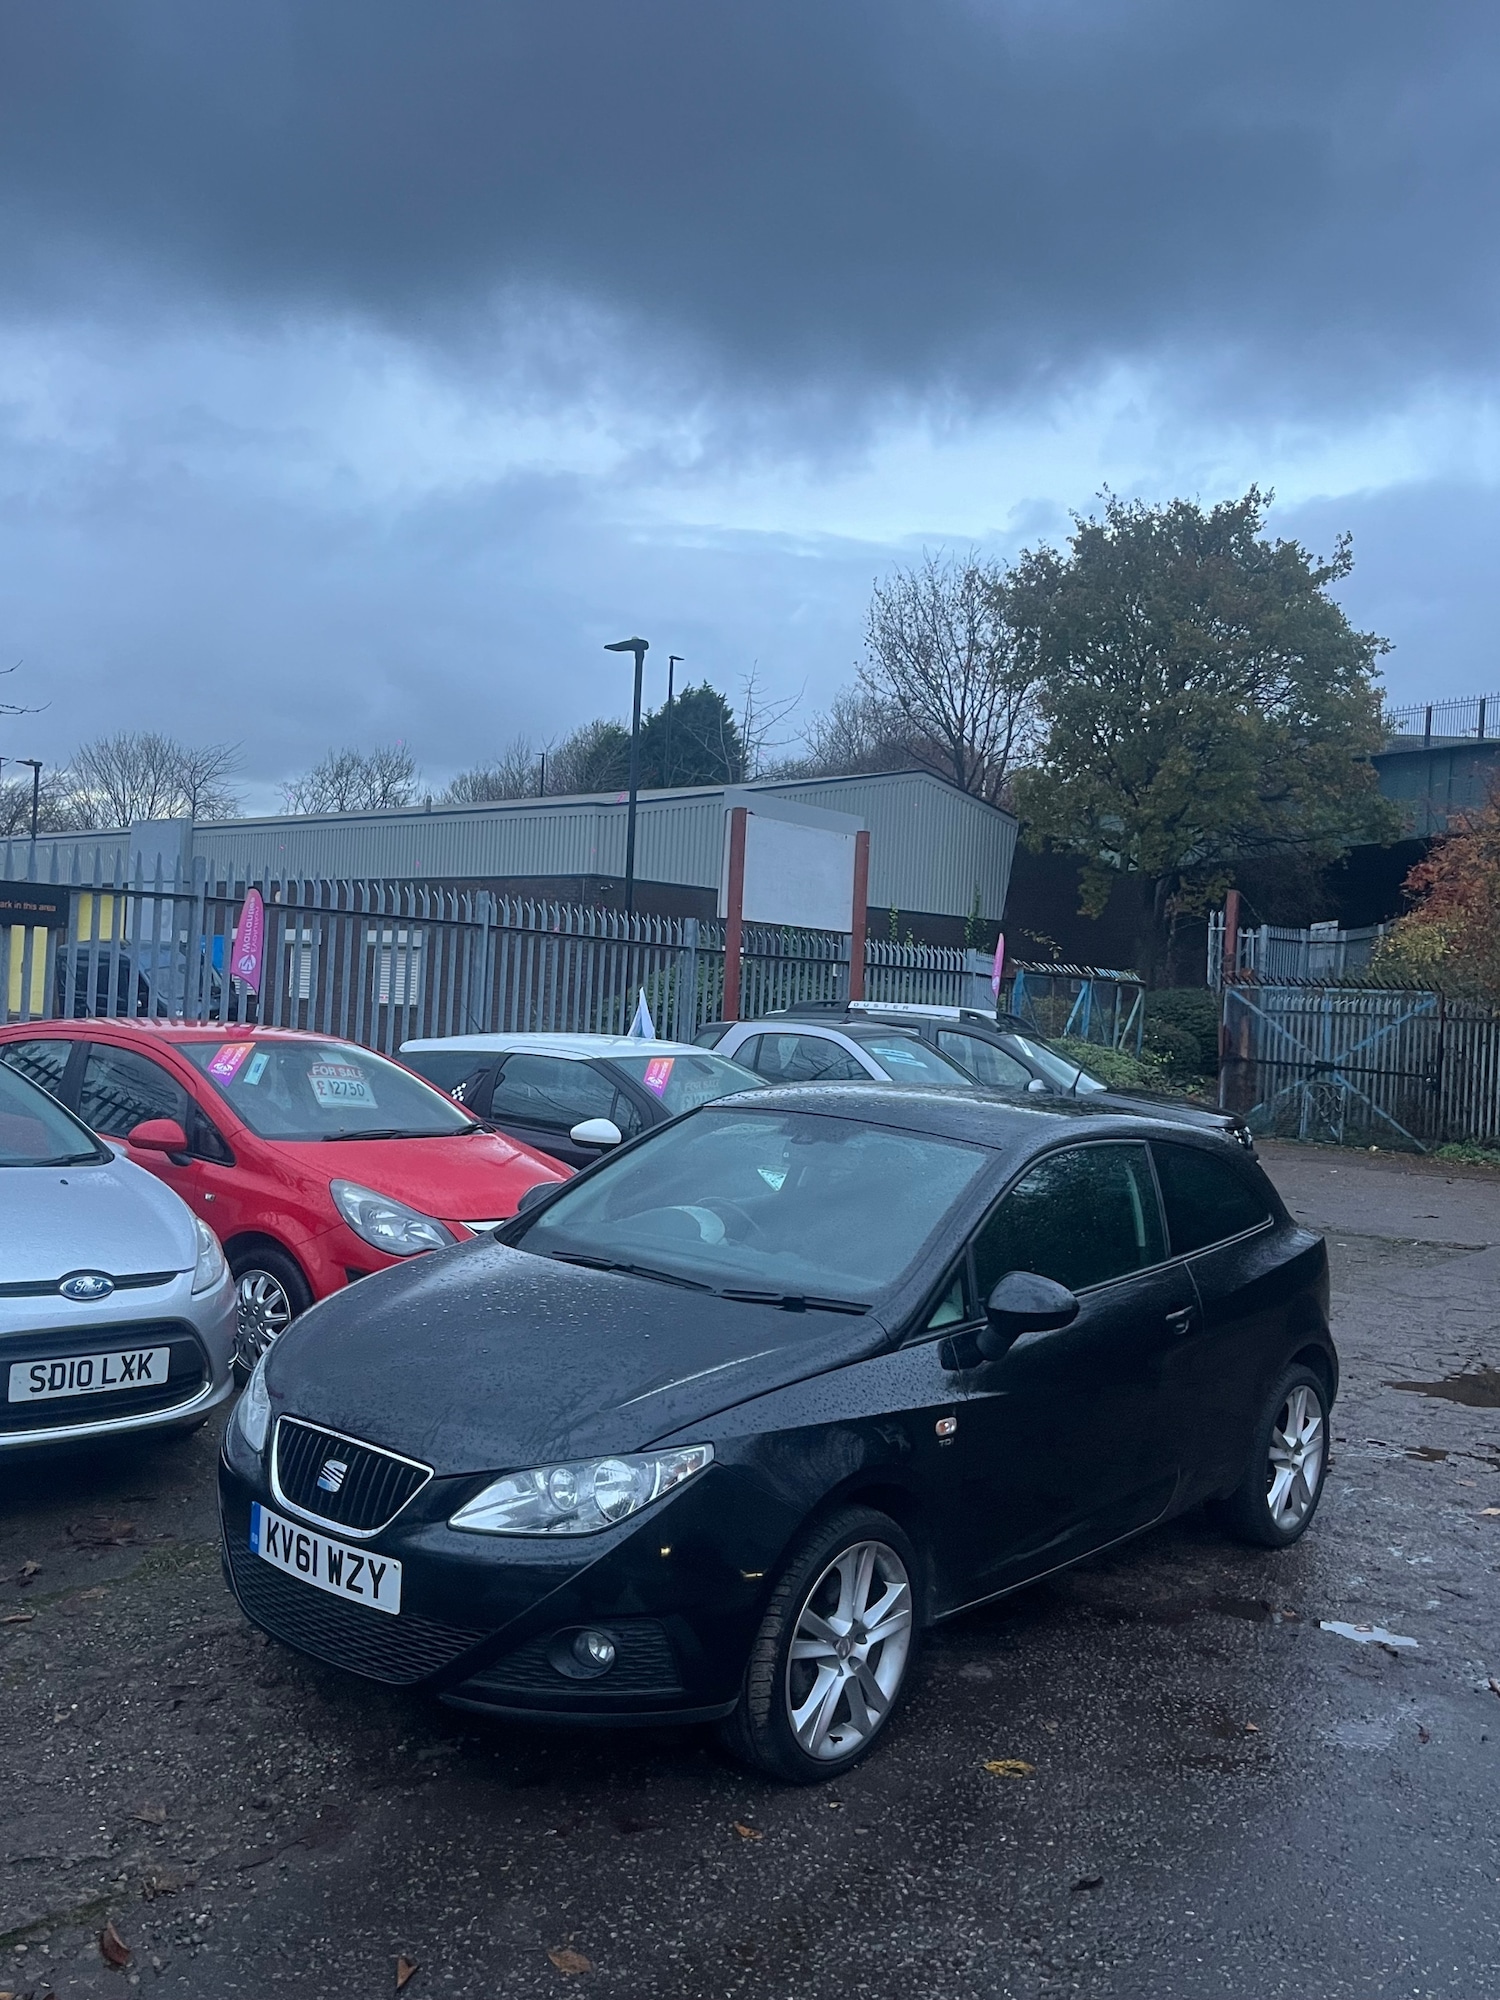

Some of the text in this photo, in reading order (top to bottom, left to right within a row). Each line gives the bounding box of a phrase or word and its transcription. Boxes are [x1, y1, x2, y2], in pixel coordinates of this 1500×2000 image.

[0, 901, 13, 909] ark
[23, 902, 37, 911] this
[38, 904, 57, 912] area
[853, 1002, 909, 1010] DUSTER
[311, 1065, 365, 1080] FOR SALE
[29, 1352, 153, 1393] SD10 LXK
[266, 1516, 387, 1600] KV61 WZY
